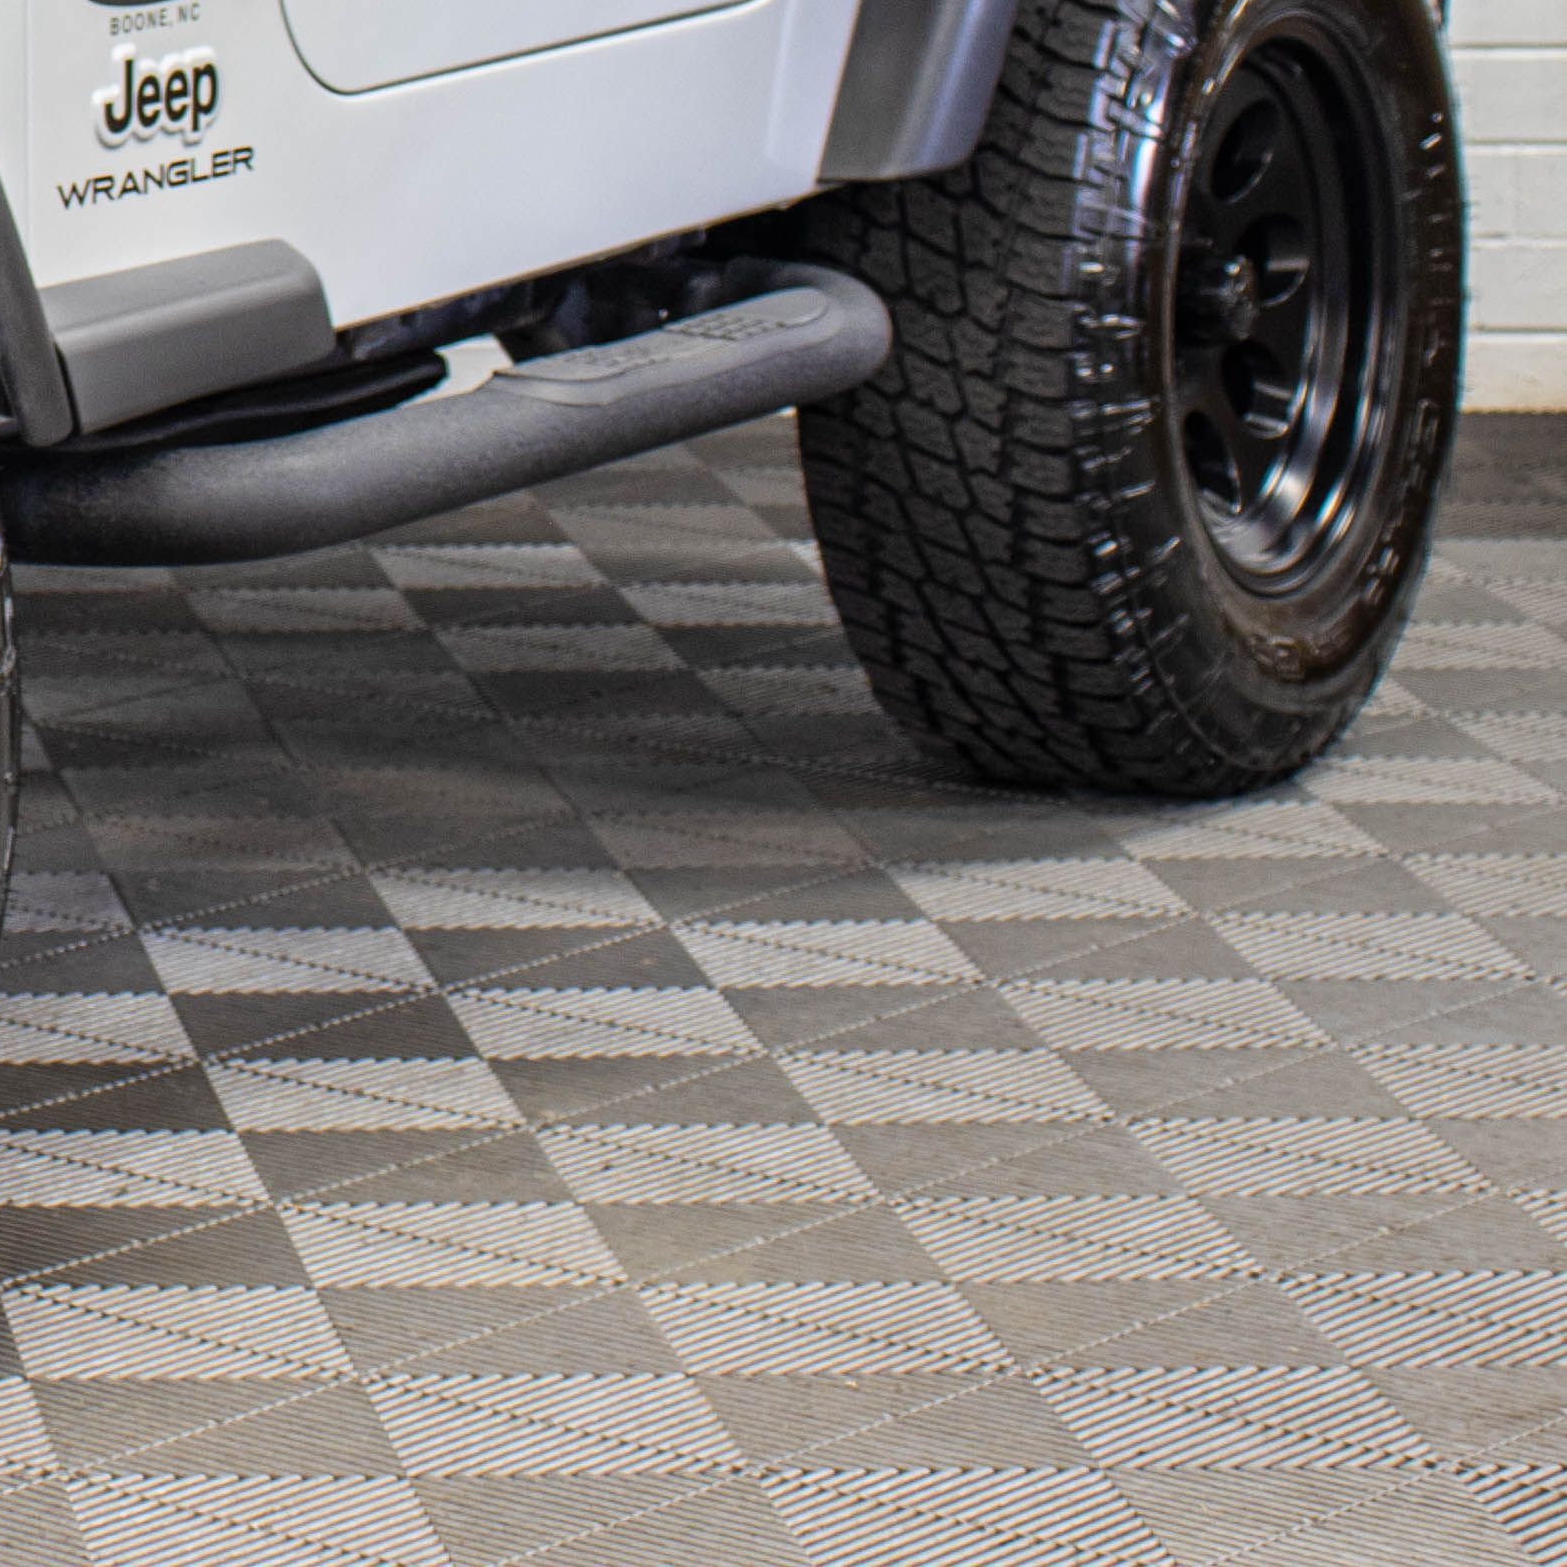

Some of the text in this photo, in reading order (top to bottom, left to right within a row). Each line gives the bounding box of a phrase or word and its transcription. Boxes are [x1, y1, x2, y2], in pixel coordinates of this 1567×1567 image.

[177, 2, 201, 23] NC
[102, 55, 219, 136] Jeep
[56, 146, 254, 210] WRANGLER
